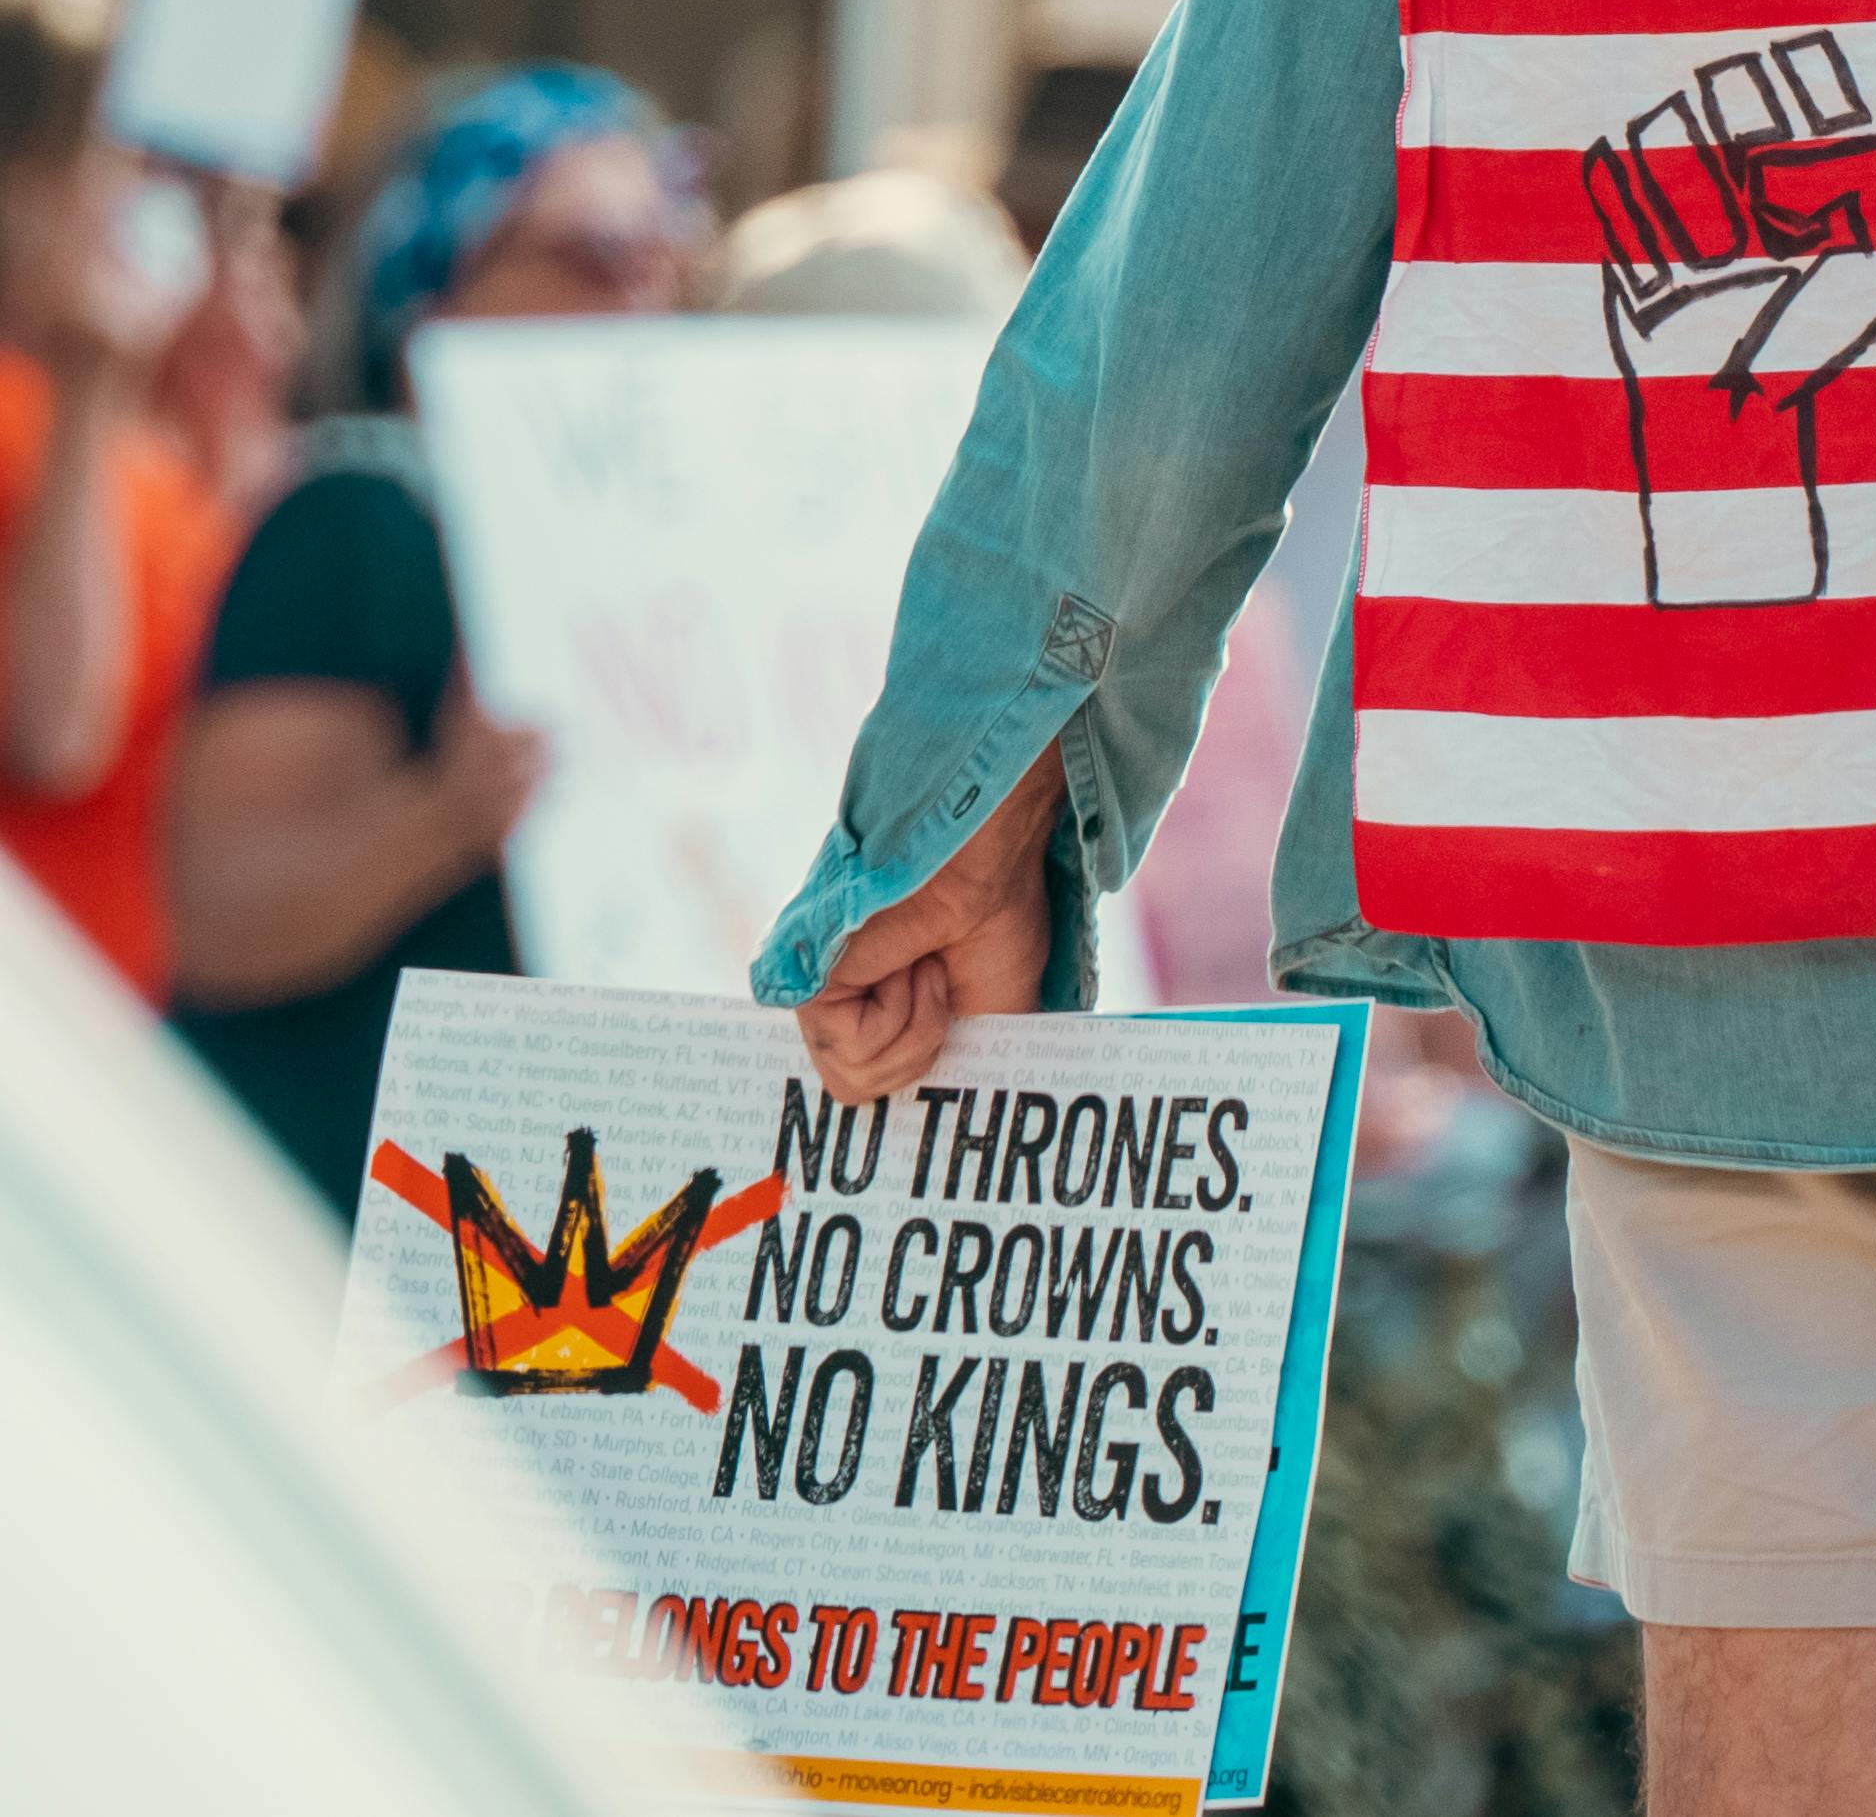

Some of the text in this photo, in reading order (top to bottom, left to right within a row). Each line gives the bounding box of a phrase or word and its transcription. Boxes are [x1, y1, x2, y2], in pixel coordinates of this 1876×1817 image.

[472, 1001, 752, 1041] NY Woodland Hills, CA Lisle, IL
[391, 1022, 425, 1041] MA
[522, 1032, 554, 1053] MD
[672, 1044, 698, 1065] FL
[710, 1049, 752, 1068] New
[986, 1038, 1012, 1058] AZ
[1024, 1040, 1099, 1062] Stillwater,
[1100, 1042, 1124, 1062] OK
[1197, 1047, 1211, 1066] IL
[1297, 1048, 1317, 1067] TX
[476, 1057, 503, 1077] AZ
[607, 1068, 638, 1087] MS
[650, 1071, 724, 1096] Rutland,
[725, 1077, 752, 1096] VT
[1011, 1067, 1037, 1086] CA
[1120, 1071, 1145, 1091] OR
[1266, 1076, 1319, 1101] Crystal
[414, 1080, 473, 1102] Mount
[516, 1088, 545, 1108] NC
[556, 1091, 615, 1115] Queen
[673, 1101, 701, 1121] AZ
[715, 1105, 766, 1125] North
[421, 1108, 518, 1134] OR South
[605, 1124, 744, 1153] Marble Falls, TX
[773, 1078, 1252, 1212] NO THRONES.
[744, 1210, 1218, 1346] NO CROWNS.
[538, 1402, 693, 1429] Lebanon, PA Fort
[712, 1344, 1221, 1525] NO KINGS.
[552, 1429, 578, 1448] SD
[590, 1432, 670, 1459] Murphys,
[671, 1437, 697, 1458] CA
[549, 1457, 576, 1475] AR
[589, 1460, 635, 1480] State
[580, 1487, 600, 1505] IN
[614, 1490, 695, 1513] Rushford,
[696, 1494, 727, 1515] MN
[1201, 1522, 1231, 1543] MA
[592, 1517, 616, 1534] LA
[629, 1519, 707, 1542] Modesto,
[709, 1525, 735, 1544] CA
[747, 1527, 808, 1552] Rogers
[847, 1534, 869, 1552] MI
[881, 1536, 971, 1563] Muskegon,
[972, 1542, 995, 1559] MI
[1006, 1543, 1095, 1567] Clearwater,
[1096, 1547, 1117, 1567] FL
[1128, 1549, 1205, 1572] Bensalem
[655, 1549, 680, 1567] NE
[782, 1556, 807, 1577] CT
[818, 1559, 873, 1581] Ocean
[938, 1568, 966, 1585] WA
[1052, 1573, 1076, 1591] TN
[1176, 1580, 1197, 1597] WI
[806, 1604, 878, 1694] TO
[888, 1608, 996, 1700] THE
[996, 1617, 1207, 1710] PEOPLE
[764, 1696, 790, 1715] CA
[801, 1699, 851, 1719] South
[852, 1704, 893, 1722] Lake
[950, 1708, 977, 1727] CA
[1162, 1720, 1180, 1737] IA
[837, 1729, 860, 1746] MI
[871, 1731, 915, 1751] Aliso
[963, 1736, 991, 1756] CA
[1082, 1744, 1111, 1761] MN
[1182, 1748, 1198, 1766] IL
[835, 1770, 953, 1804] moveon.org
